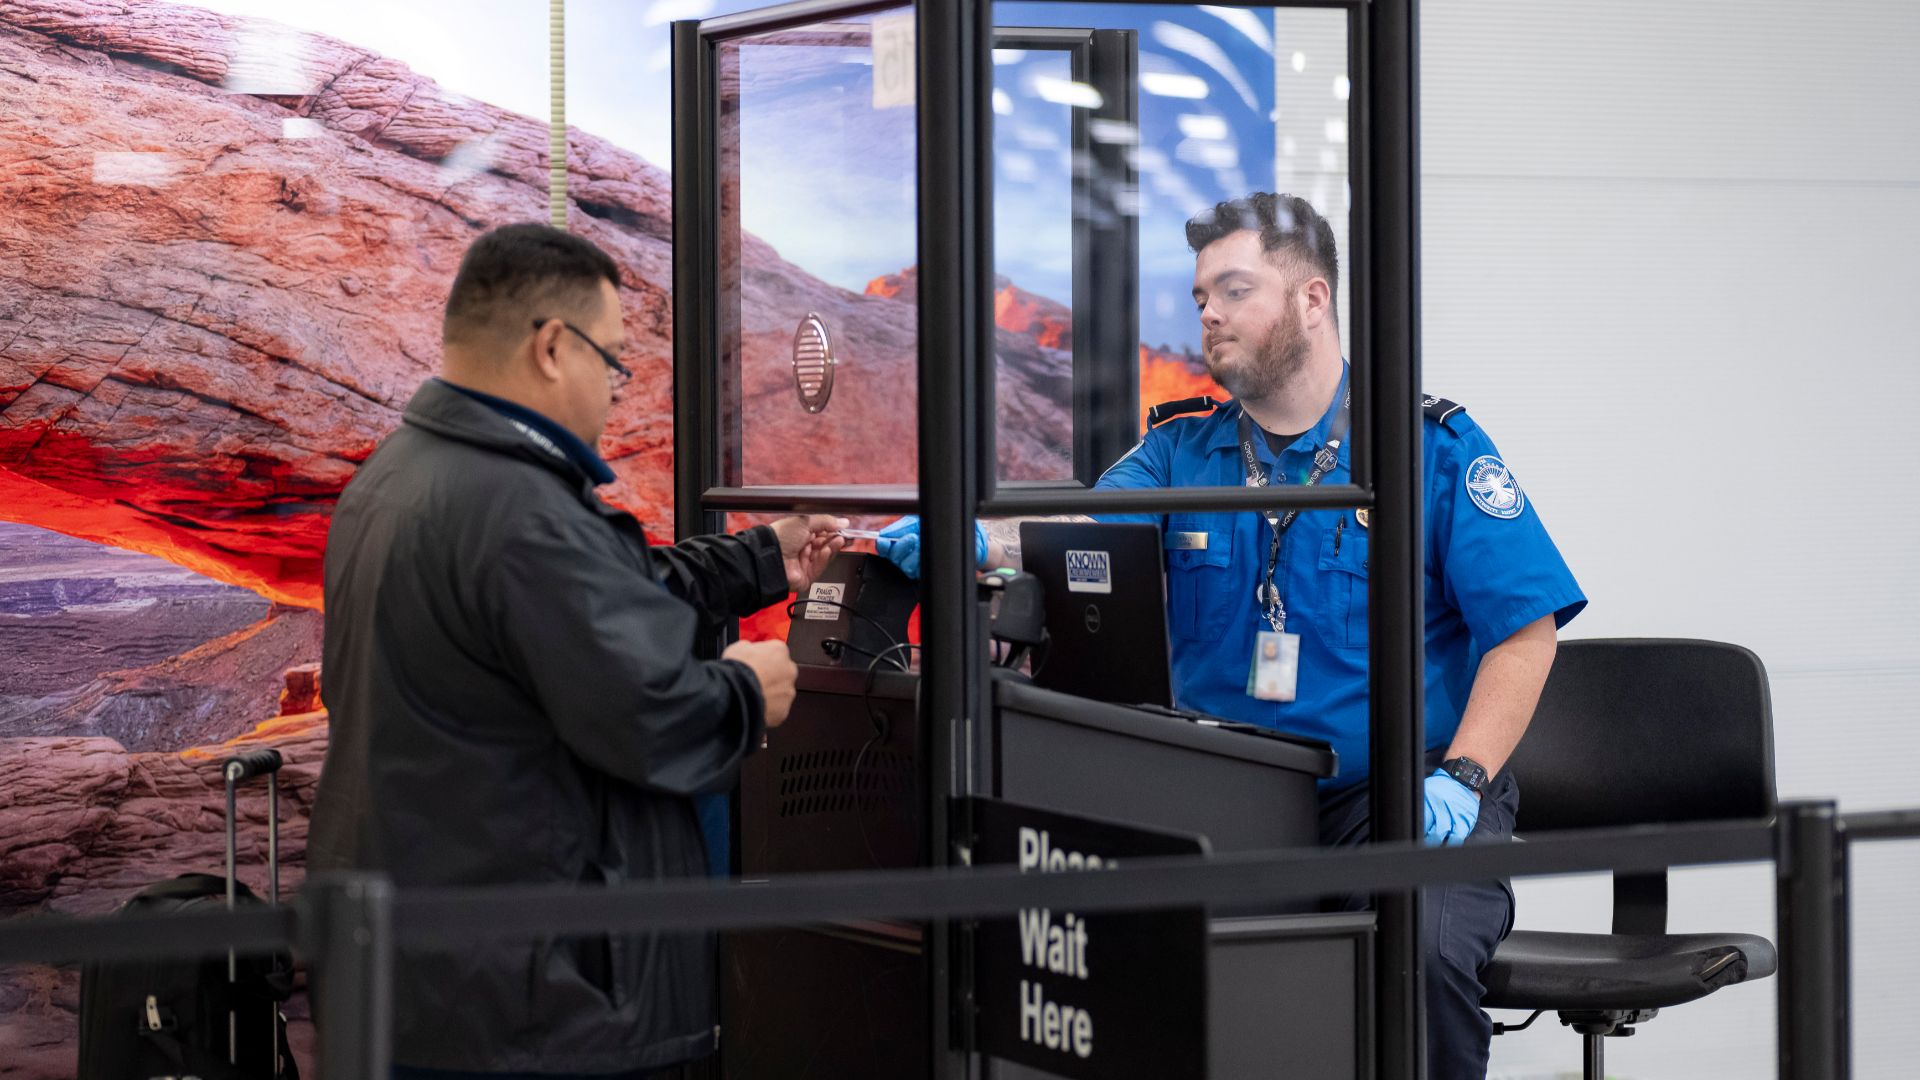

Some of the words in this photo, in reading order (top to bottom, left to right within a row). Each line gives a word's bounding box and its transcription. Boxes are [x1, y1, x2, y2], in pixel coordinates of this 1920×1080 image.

[1244, 441, 1254, 463] COACH
[1068, 551, 1107, 570] KNOWN
[815, 587, 833, 596] FRAUD
[1019, 908, 1089, 980] Wait
[1020, 979, 1094, 1058] Here
